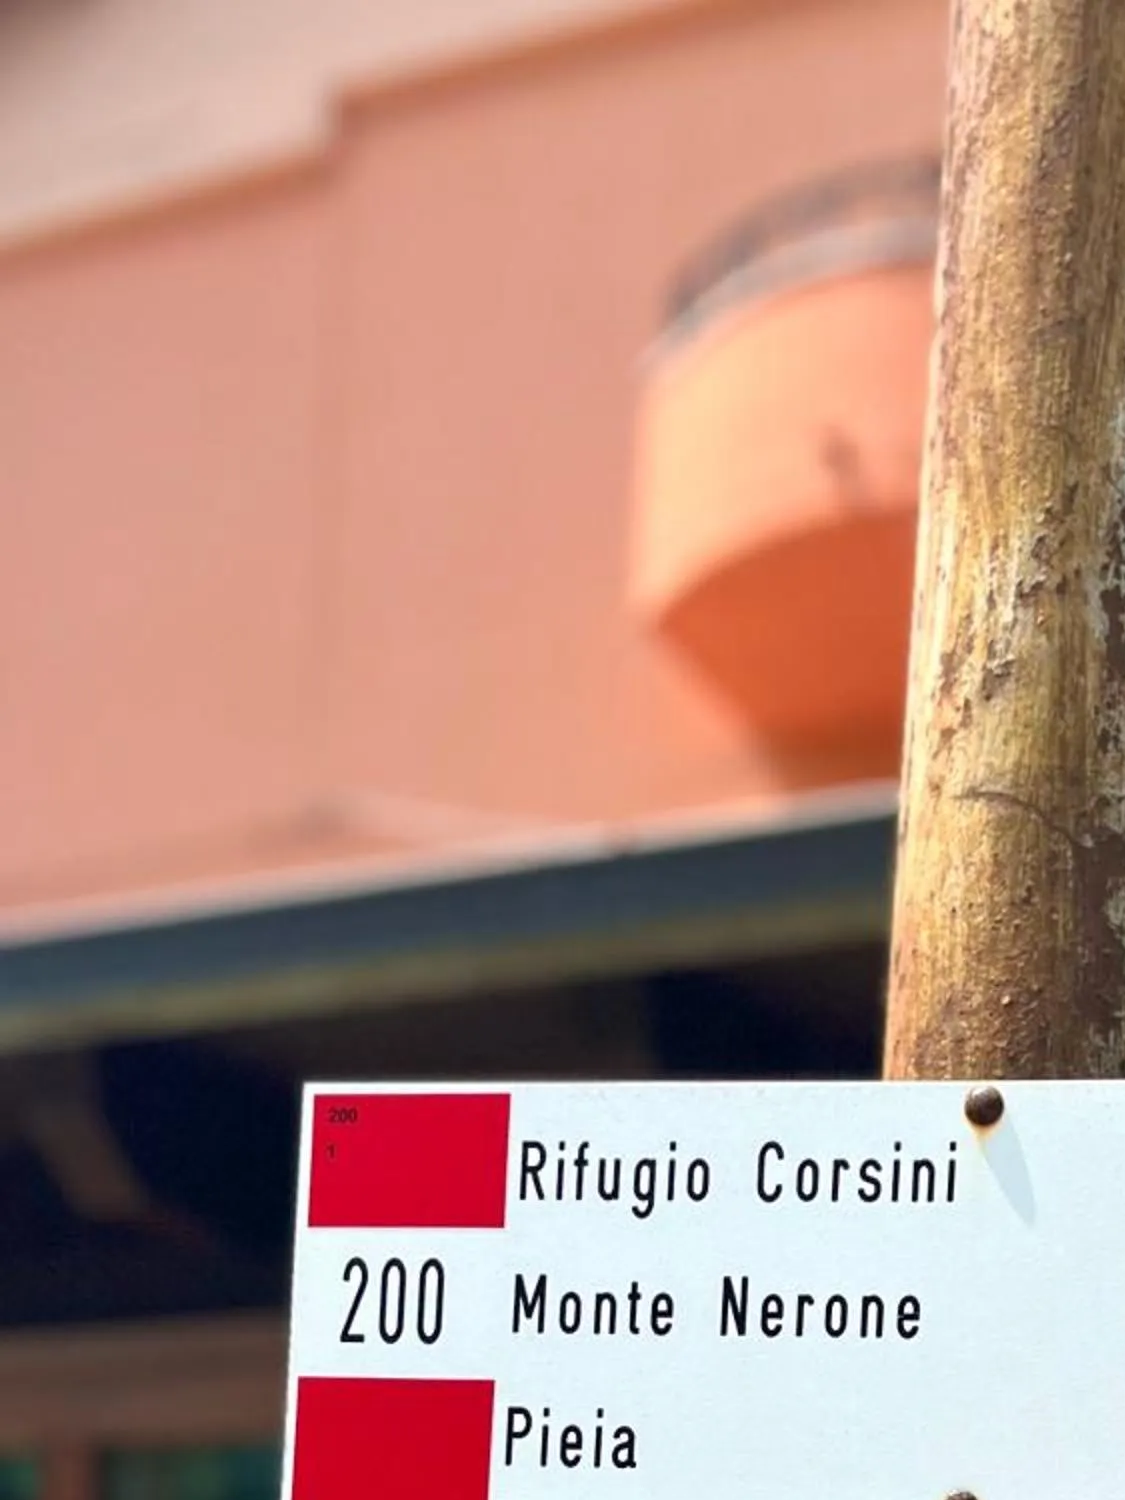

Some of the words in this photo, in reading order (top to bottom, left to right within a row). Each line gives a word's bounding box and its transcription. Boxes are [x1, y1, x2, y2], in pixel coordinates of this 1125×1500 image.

[328, 1107, 358, 1123] 200
[326, 1143, 335, 1159] 1
[519, 1140, 711, 1219] Rifugio
[757, 1140, 958, 1203] Corsini
[339, 1257, 446, 1345] 200
[512, 1273, 675, 1337] Monte
[720, 1275, 922, 1340] Nerone
[505, 1406, 638, 1469] Pieia
